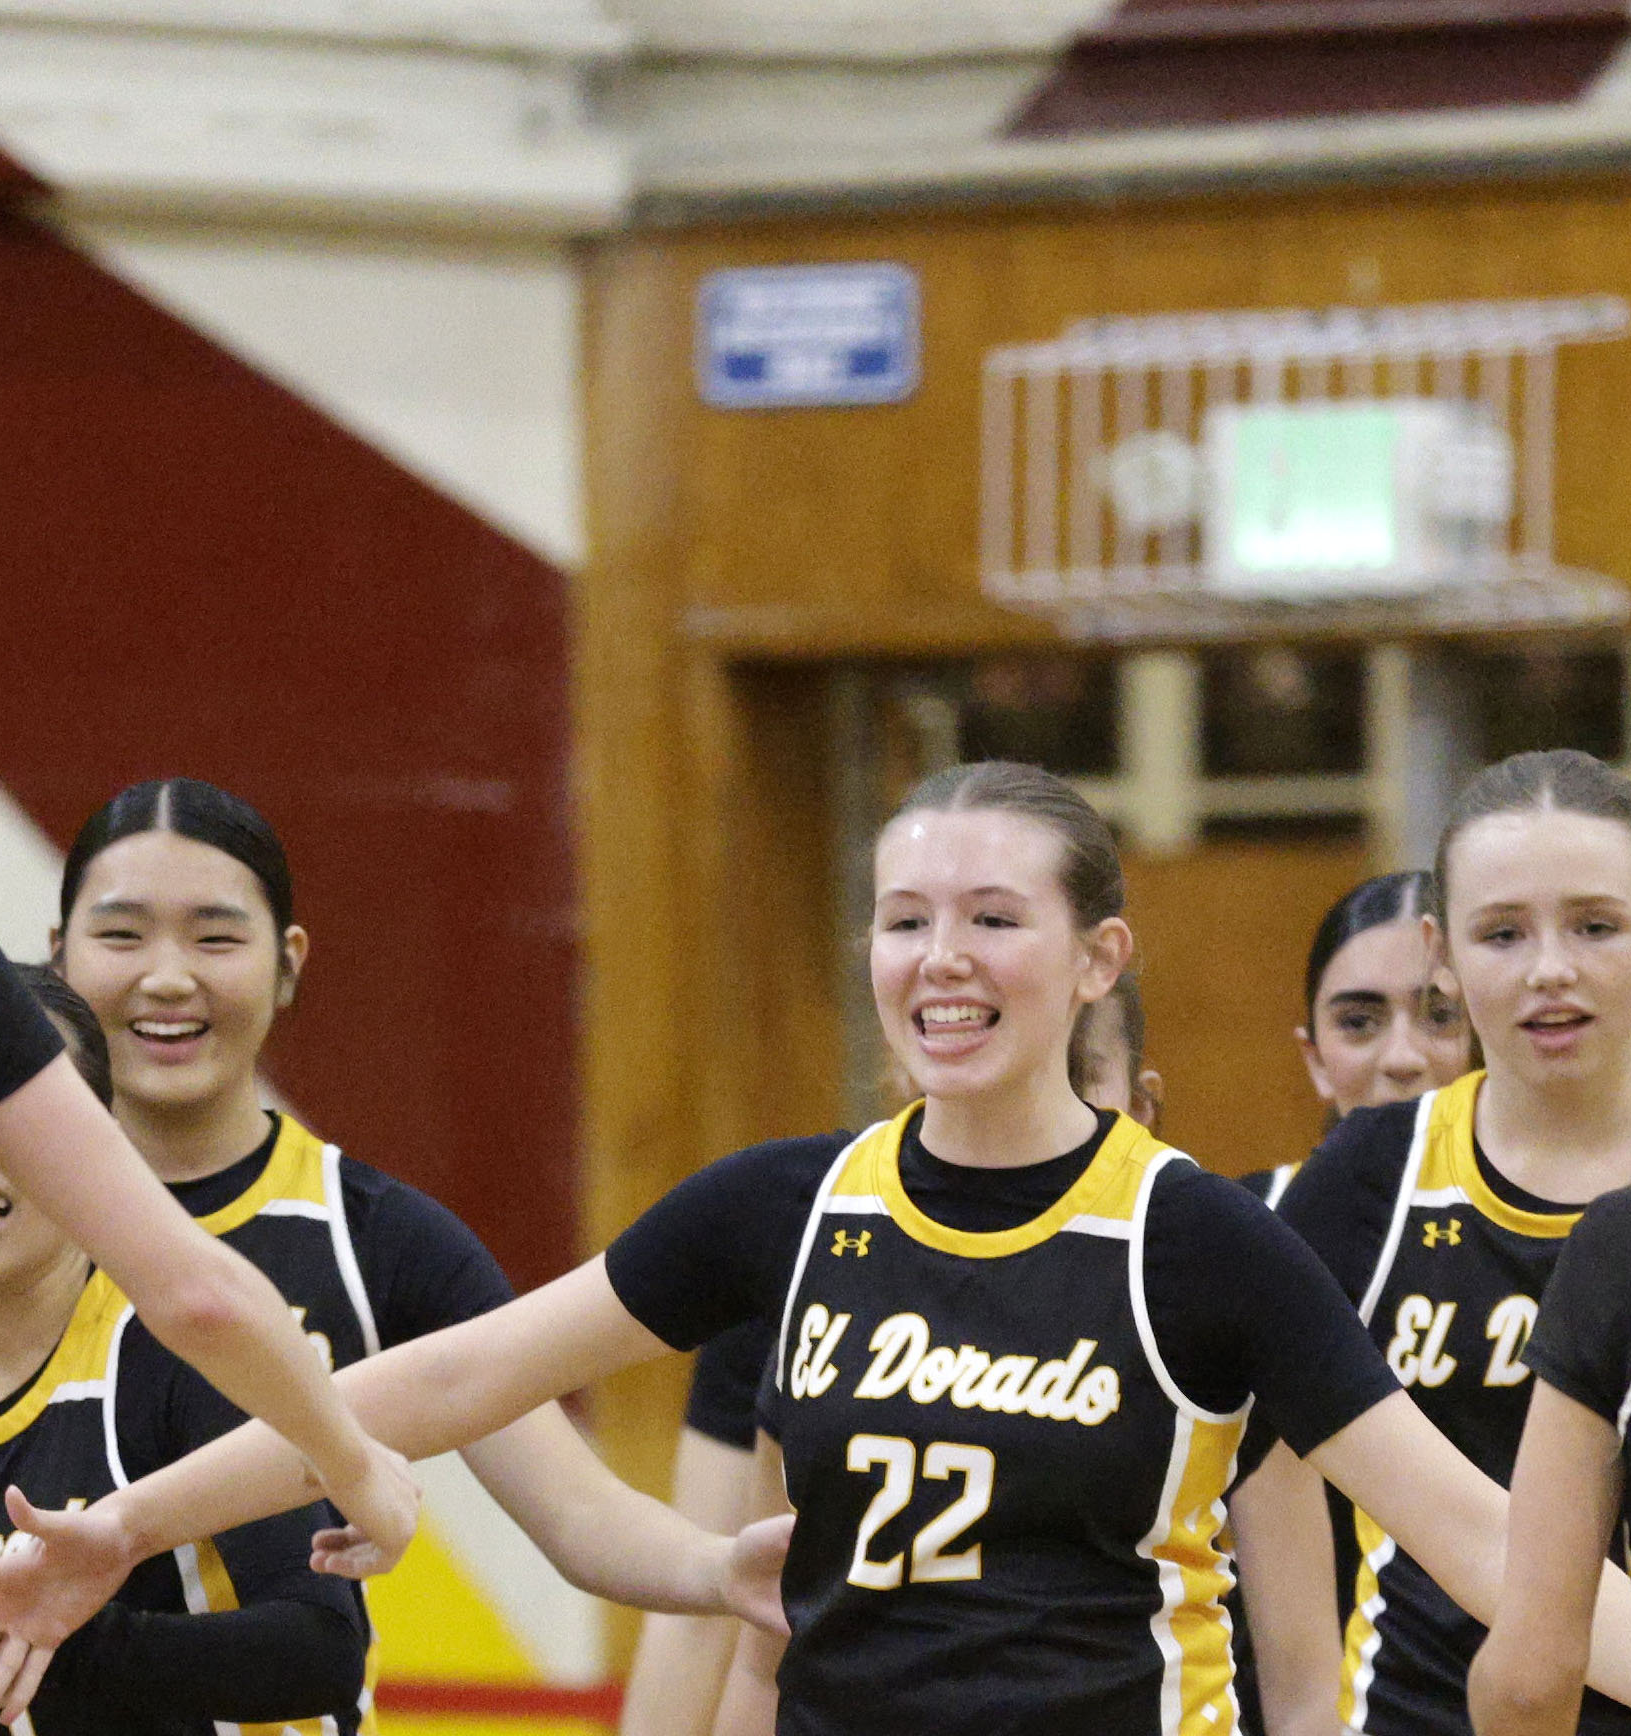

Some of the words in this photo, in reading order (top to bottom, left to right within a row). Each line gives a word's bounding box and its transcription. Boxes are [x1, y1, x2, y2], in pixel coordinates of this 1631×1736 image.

[790, 1303, 852, 1400] El
[853, 1312, 1120, 1426] Dorado
[1386, 1294, 1458, 1388] El
[847, 1433, 996, 1591] 22
